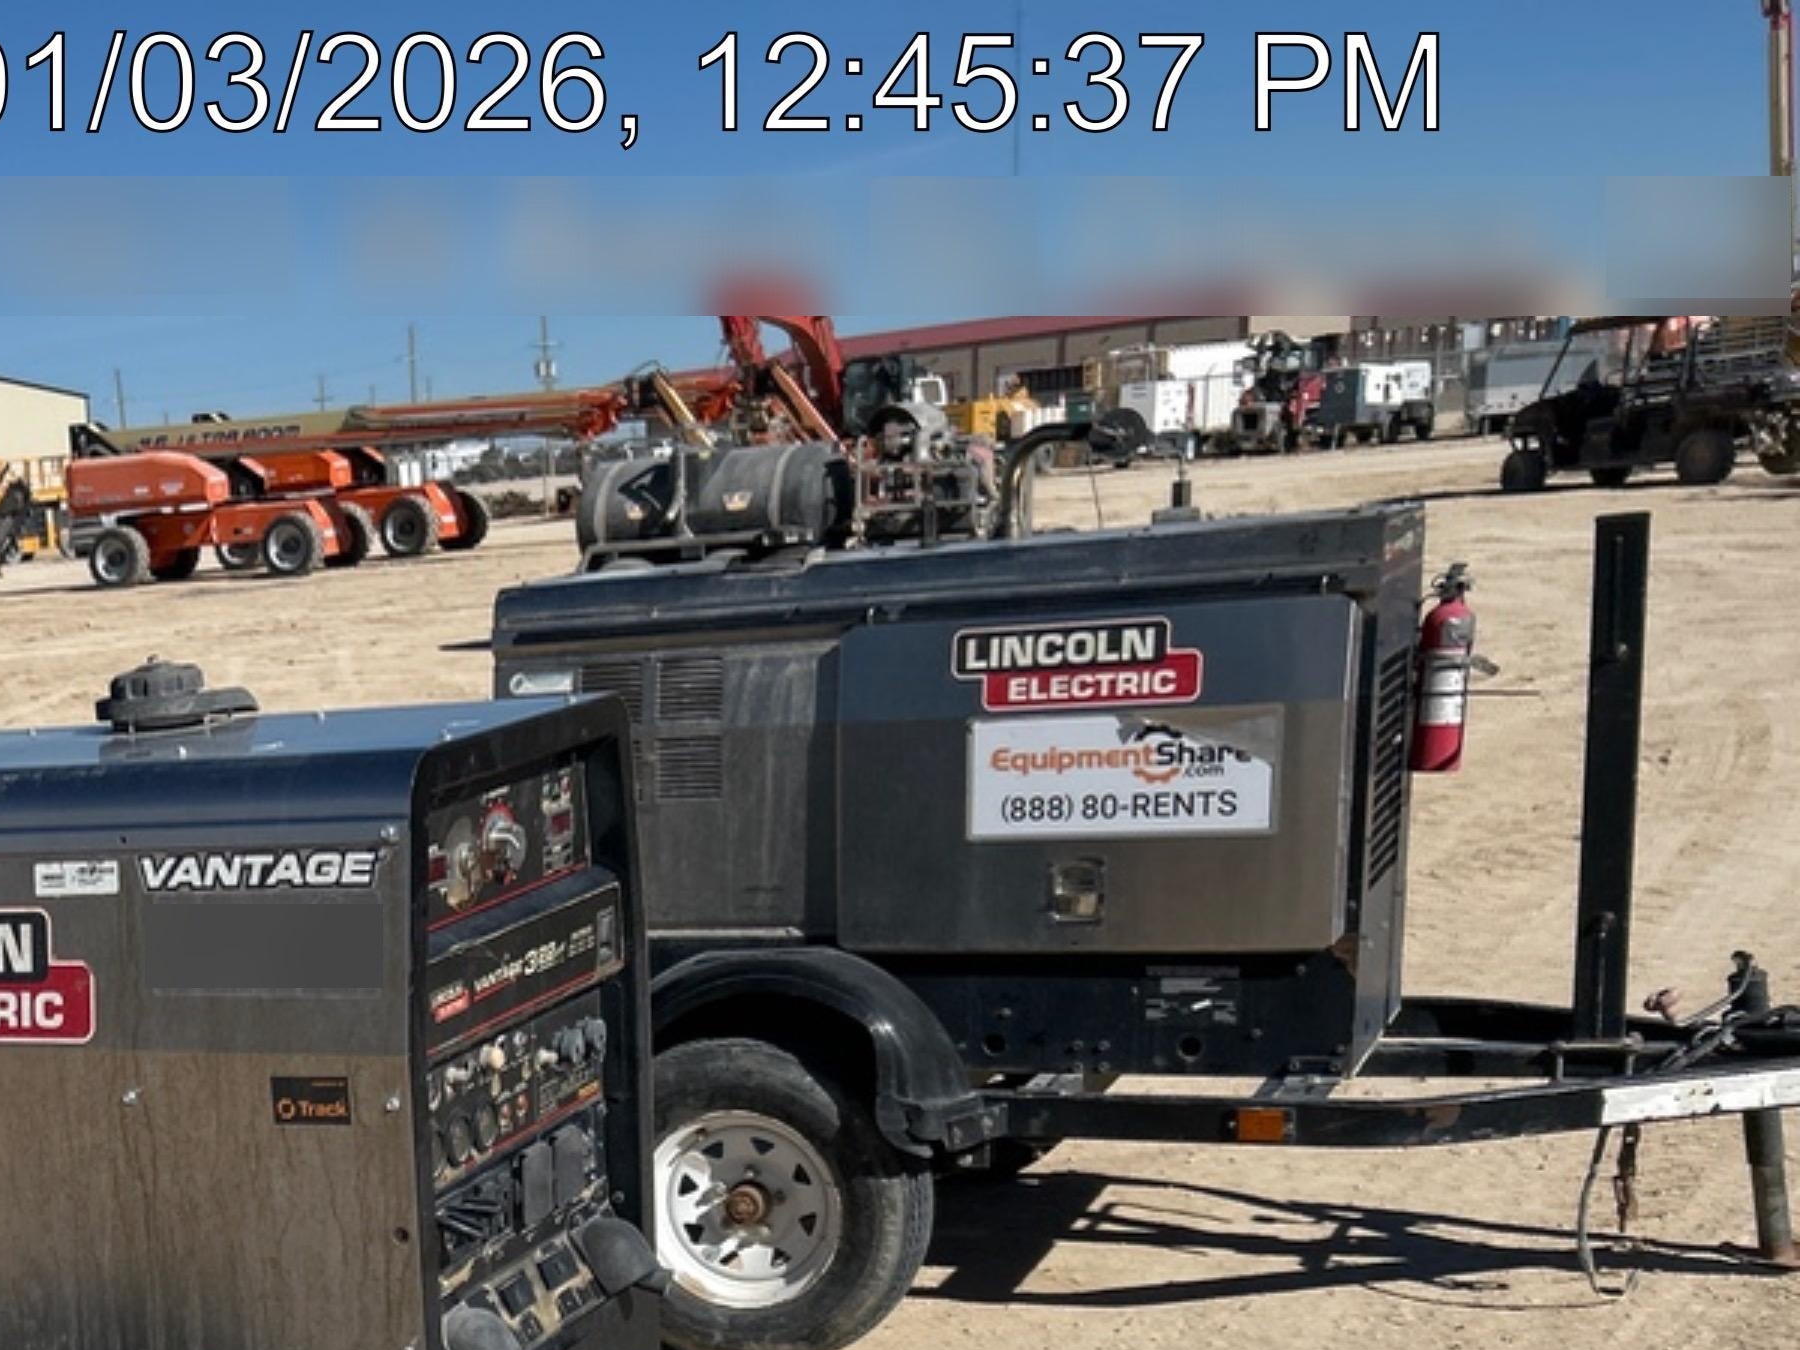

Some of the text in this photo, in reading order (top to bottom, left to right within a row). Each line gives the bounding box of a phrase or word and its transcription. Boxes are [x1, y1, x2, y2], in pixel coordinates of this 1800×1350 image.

[965, 626, 1156, 670] LINCOLN
[1007, 669, 1177, 702] ELECTRIC
[1001, 790, 1237, 823] (888) 80-RENTS
[141, 851, 376, 889] VANTAGE
